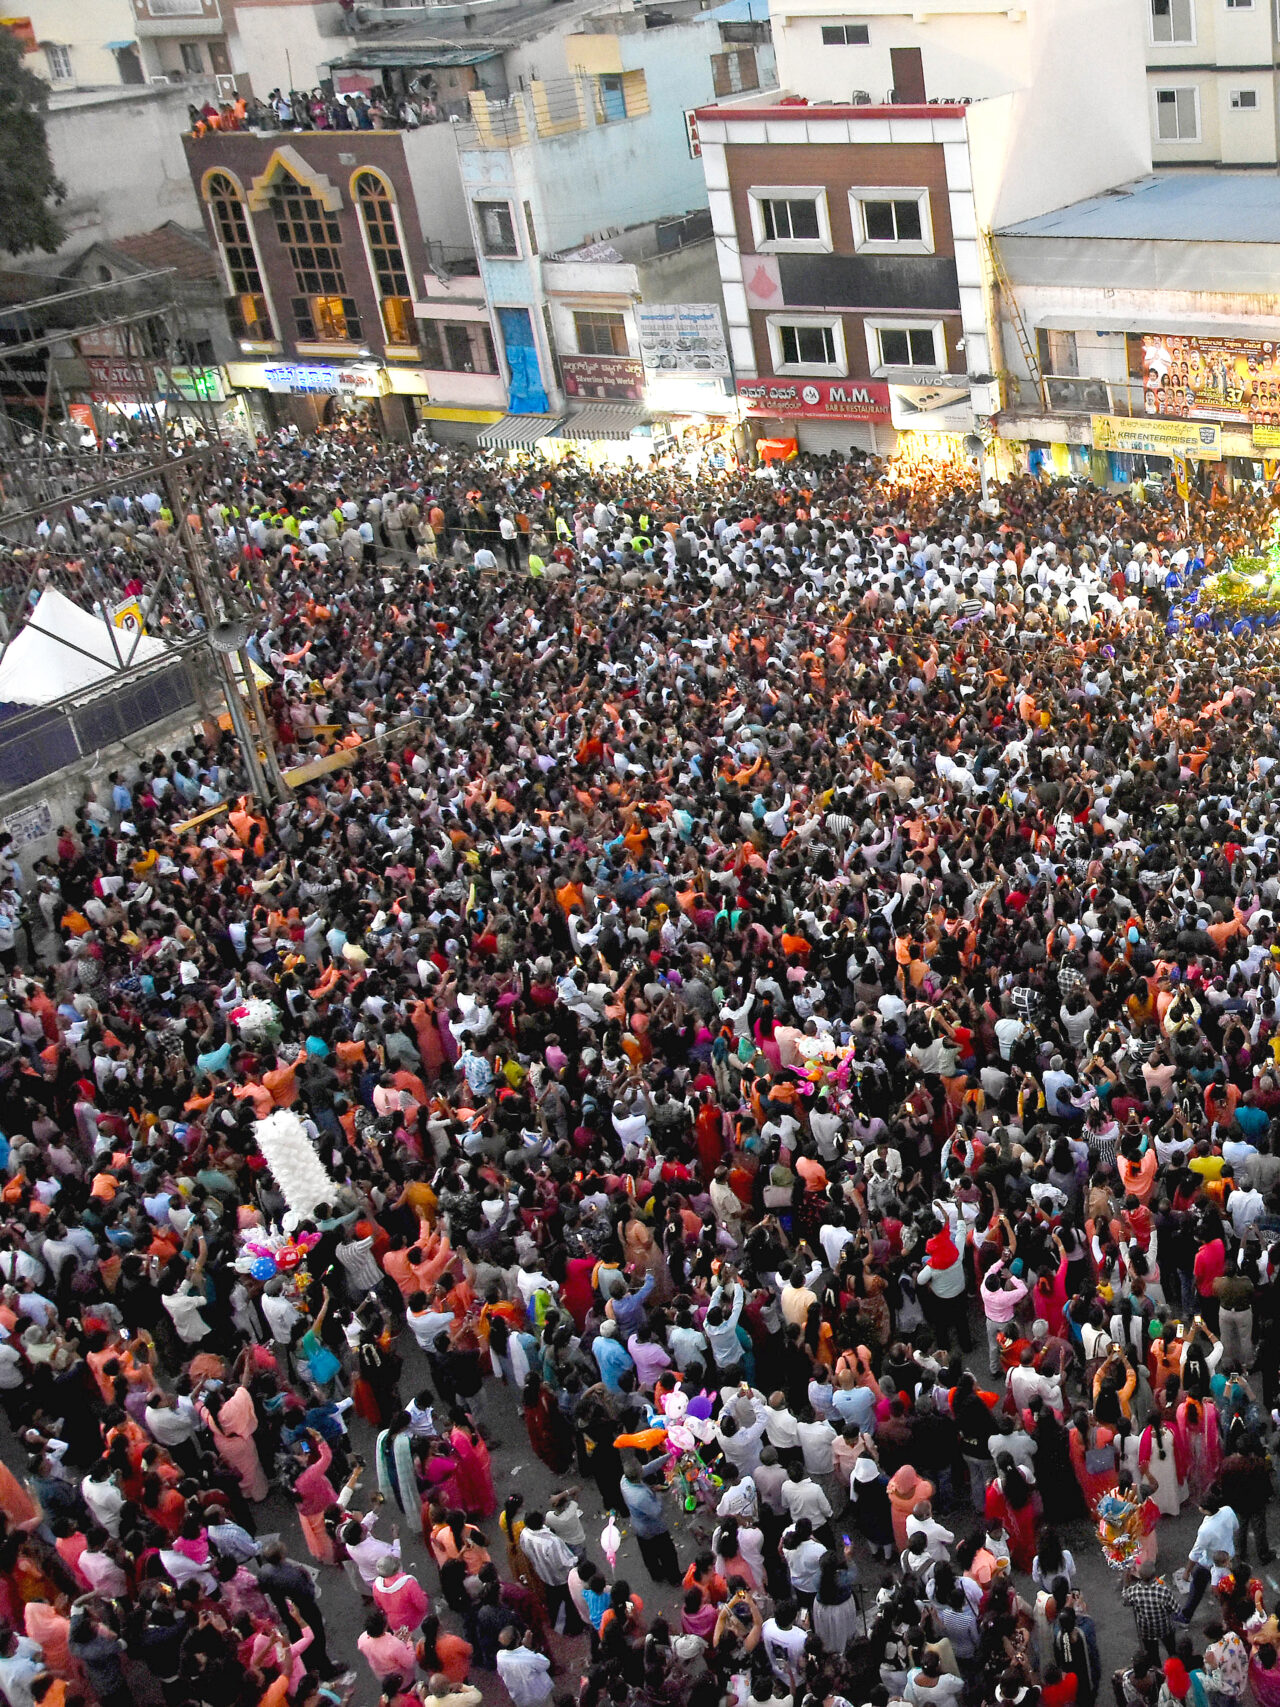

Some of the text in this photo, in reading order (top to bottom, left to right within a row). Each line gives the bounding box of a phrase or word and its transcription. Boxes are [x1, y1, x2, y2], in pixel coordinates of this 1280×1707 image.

[0, 370, 48, 382] AMSUNG
[913, 377, 943, 386] vivo
[829, 387, 875, 403] M.M.
[1226, 387, 1244, 403] 37
[825, 403, 839, 412] BAR
[846, 405, 889, 414] RESTAURANT
[1137, 433, 1198, 444] ENTERPRISES
